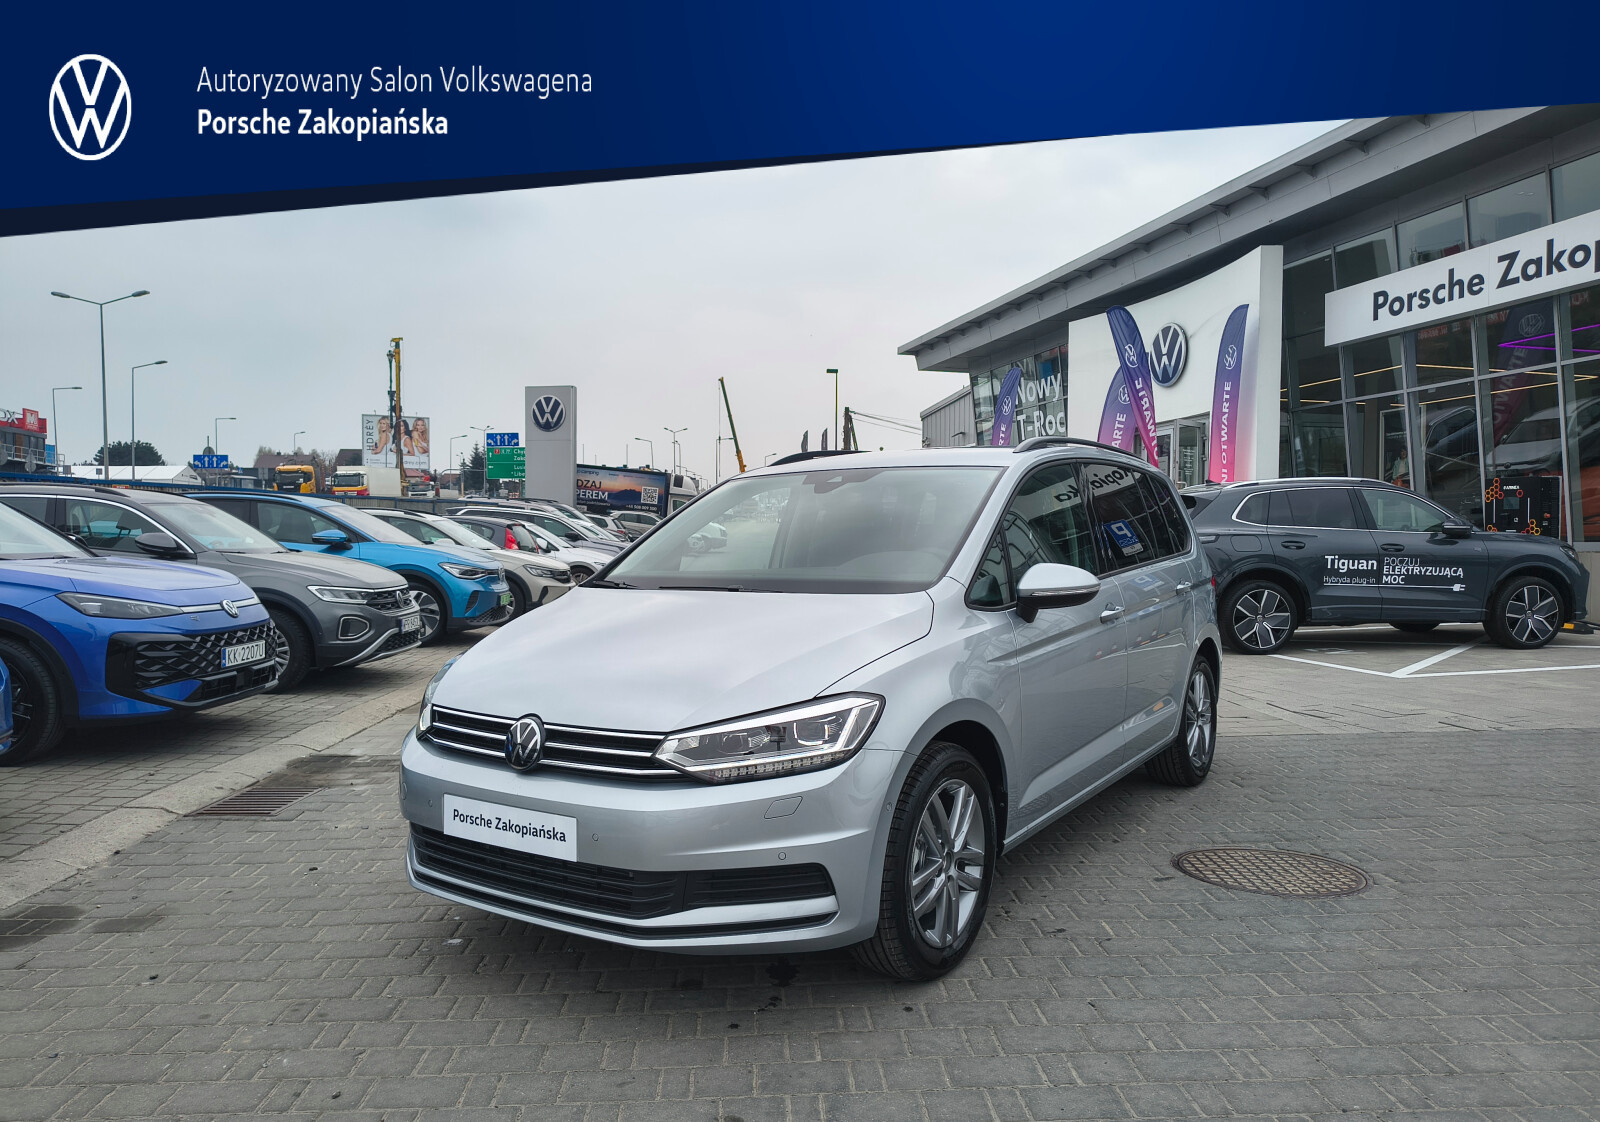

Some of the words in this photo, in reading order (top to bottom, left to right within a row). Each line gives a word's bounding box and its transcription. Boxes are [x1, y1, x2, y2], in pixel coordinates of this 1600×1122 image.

[1373, 267, 1485, 321] Porsche
[1496, 238, 1600, 289] Zako
[1016, 373, 1061, 405] Nowy
[1017, 410, 1066, 441] T-Roc
[1221, 381, 1231, 464] OTWARTE
[1325, 555, 1377, 573] Tiguan
[1384, 557, 1420, 567] POCZUJ
[1383, 566, 1464, 579] ELEKTRYZUJĄCĄ
[1323, 575, 1351, 585] Hybryda
[1352, 576, 1376, 585] plug-in
[1382, 575, 1406, 584] MOC
[227, 648, 239, 665] KK
[241, 643, 264, 662] 2207U
[453, 808, 492, 829] Porsche
[495, 816, 567, 843] Zakopiańska
